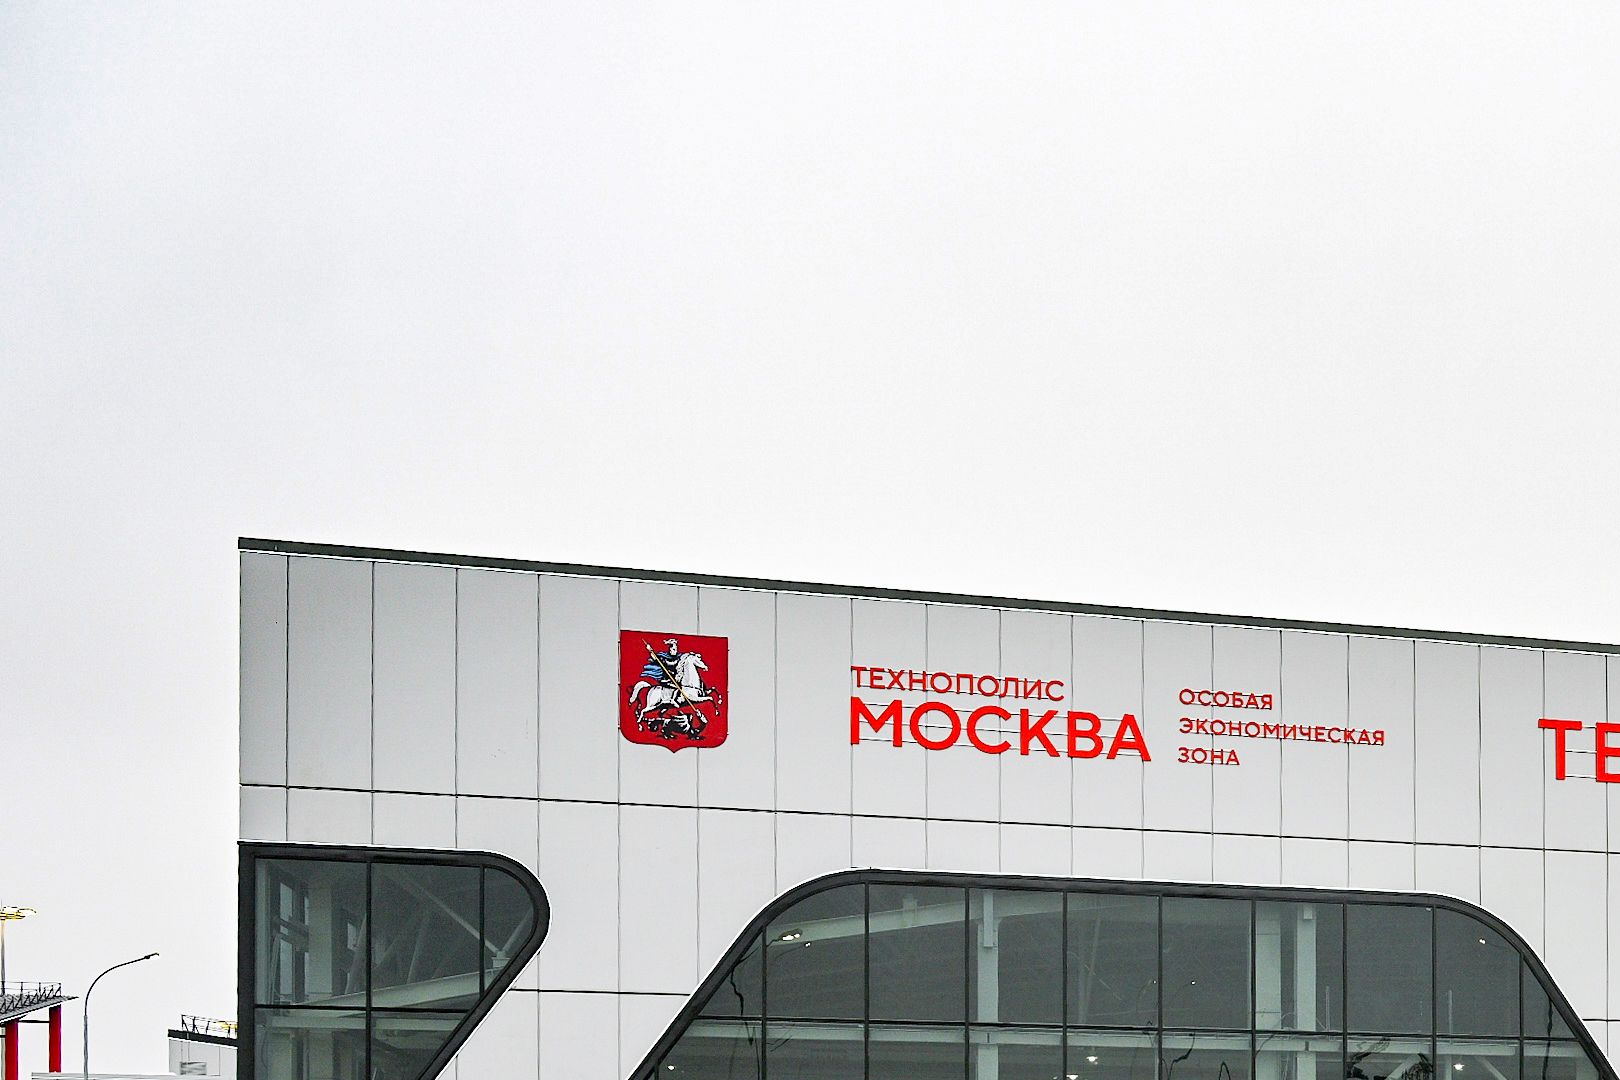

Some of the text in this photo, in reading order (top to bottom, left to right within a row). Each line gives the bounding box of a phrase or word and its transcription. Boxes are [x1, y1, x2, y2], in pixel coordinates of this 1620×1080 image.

[850, 665, 1064, 701] ТЕХНОПОЛИС
[1178, 688, 1273, 710] ОСОБАЯ
[850, 695, 1152, 761] МОСКВА
[1179, 717, 1385, 746] ЭКОНОМИЧЕСКАЯ
[1177, 746, 1240, 766] ЗОНА
